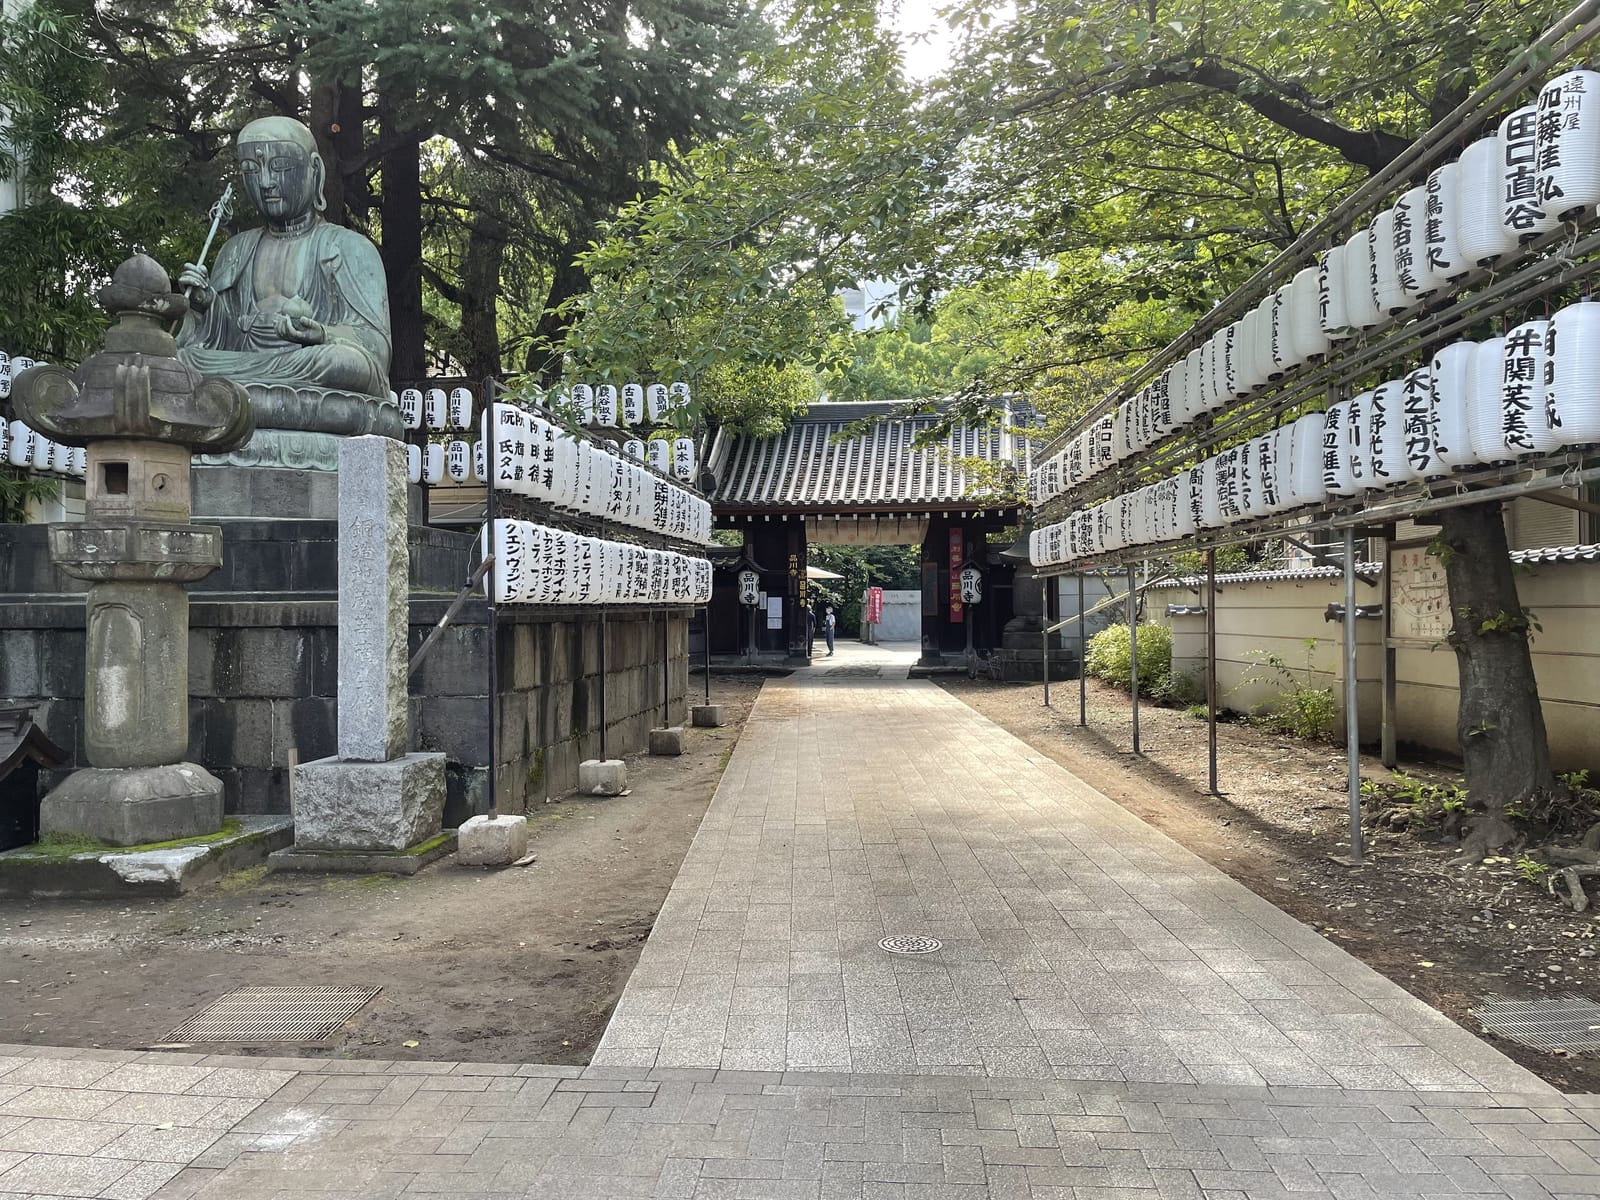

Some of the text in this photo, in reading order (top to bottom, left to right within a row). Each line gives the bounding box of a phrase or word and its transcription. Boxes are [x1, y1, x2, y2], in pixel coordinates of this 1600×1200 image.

[1562, 75, 1587, 131] 遠州屋
[403, 391, 416, 425] 品川寺
[451, 442, 464, 477] 品川寺
[743, 572, 755, 604] 品川寺
[962, 571, 974, 603] 品川寺
